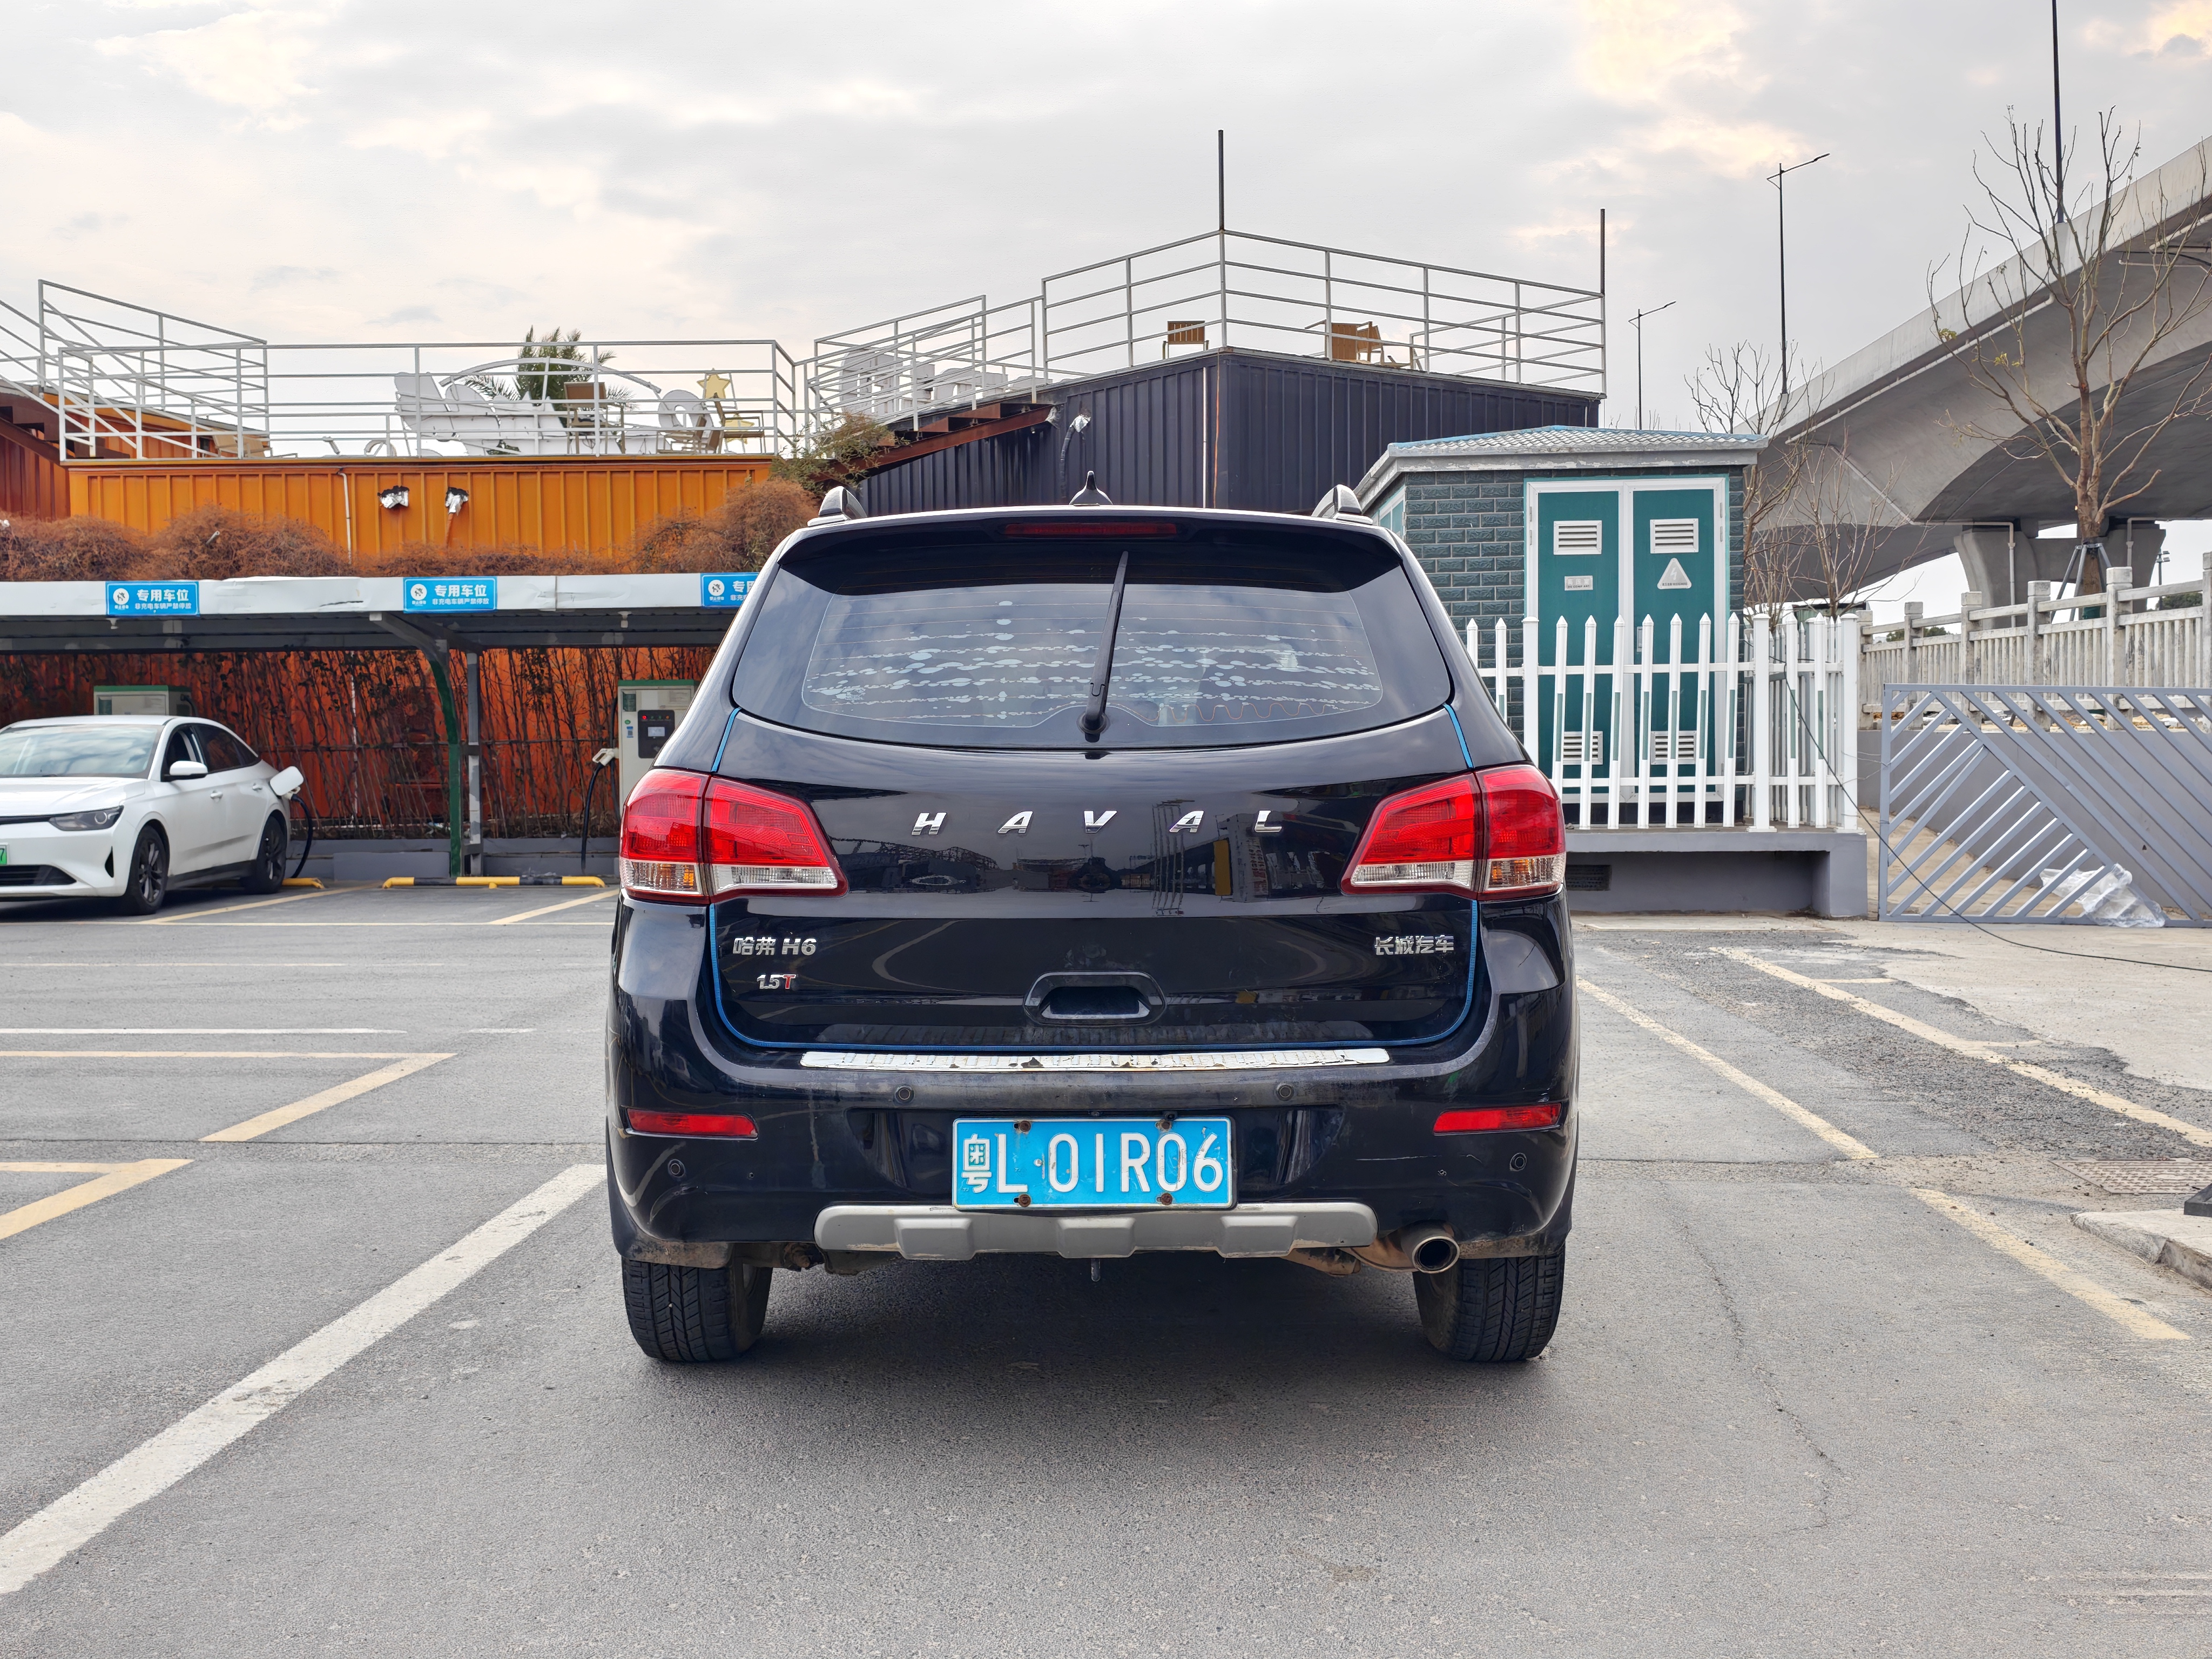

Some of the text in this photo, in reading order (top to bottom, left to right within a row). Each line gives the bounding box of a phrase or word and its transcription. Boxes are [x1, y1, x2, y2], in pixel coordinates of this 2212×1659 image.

[137, 589, 188, 602] 专用车位
[435, 584, 487, 597] 专用车位
[911, 811, 1282, 835] HAVAL
[733, 936, 817, 956] 哈弗 H6
[1374, 935, 1454, 955] 长城汽车
